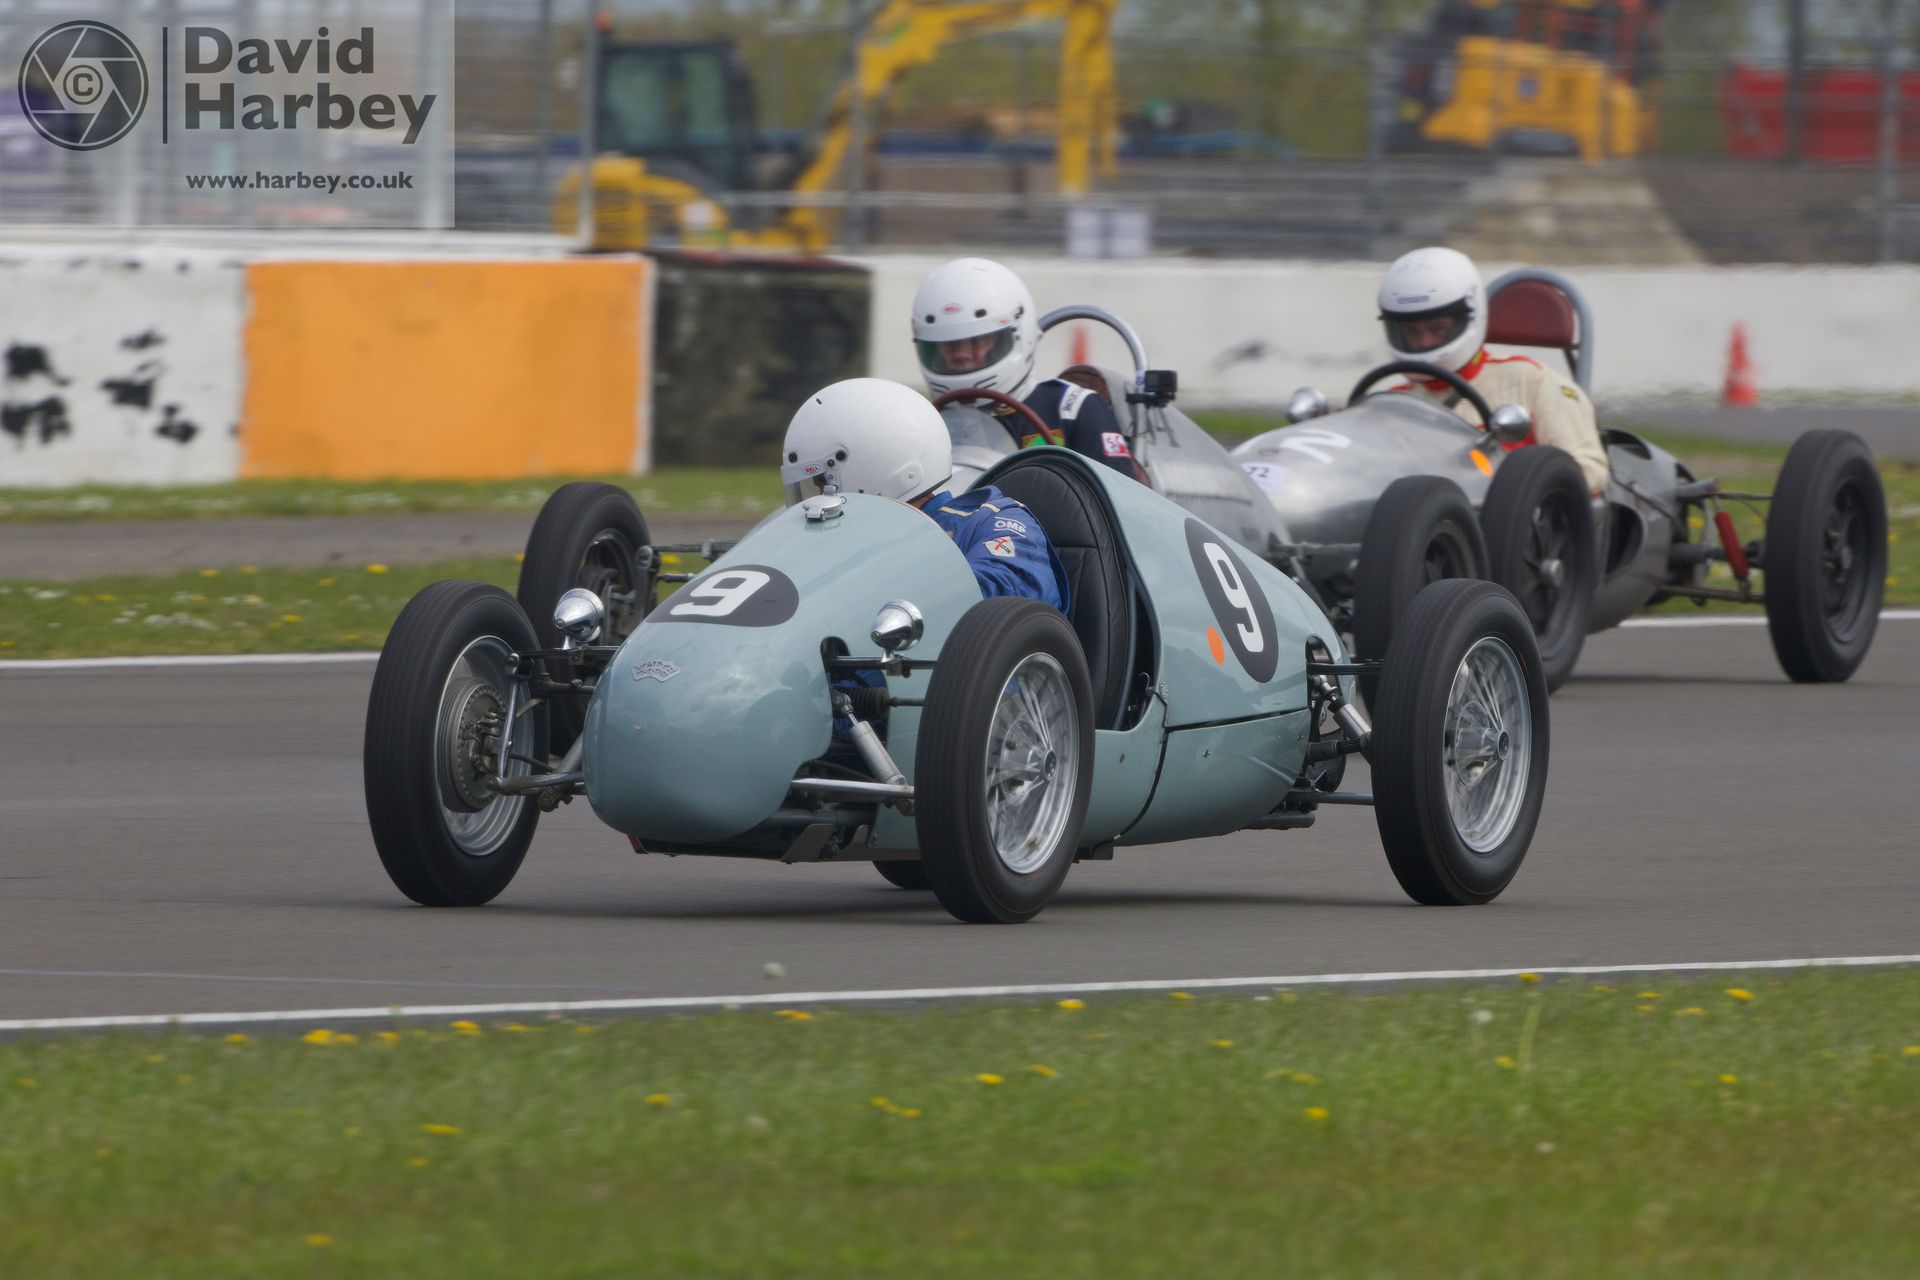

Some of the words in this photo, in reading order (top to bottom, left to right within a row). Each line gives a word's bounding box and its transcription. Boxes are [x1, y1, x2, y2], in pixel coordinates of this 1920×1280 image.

[994, 519, 1027, 534] OMP
[669, 570, 770, 617] 9
[1203, 542, 1265, 652] 9
